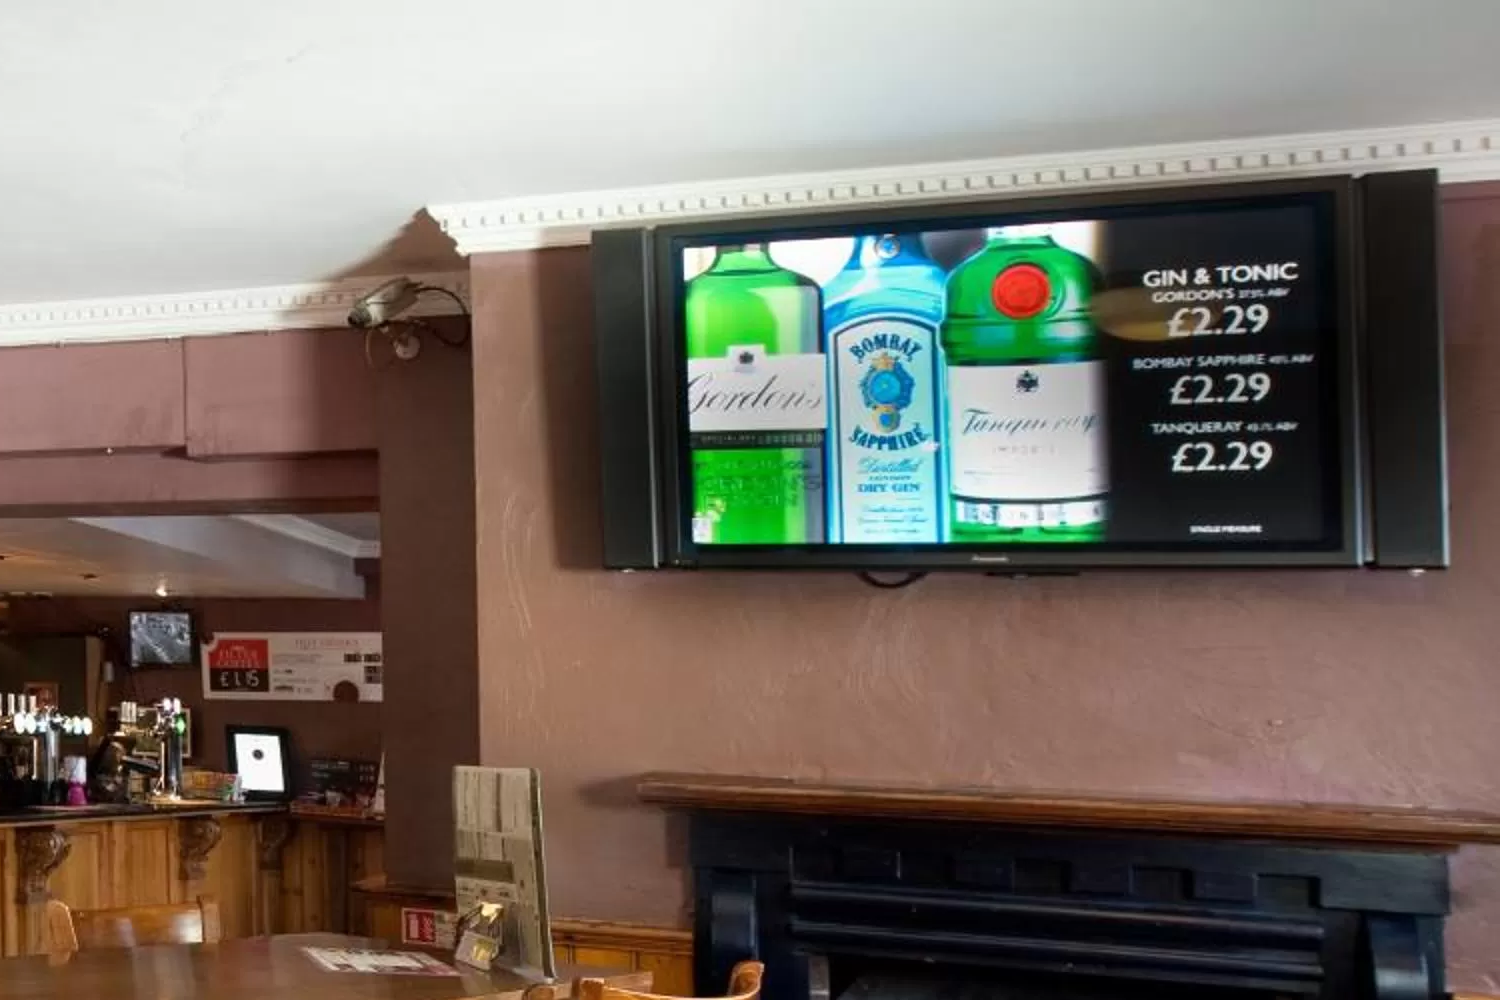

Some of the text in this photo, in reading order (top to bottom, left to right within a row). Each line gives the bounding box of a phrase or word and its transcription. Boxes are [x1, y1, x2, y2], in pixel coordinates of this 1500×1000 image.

[1143, 262, 1299, 288] GIN & TONIC
[1152, 287, 1234, 303] GORDON'S
[1166, 303, 1270, 337] £2.29
[849, 333, 923, 364] BOMBAY
[1132, 356, 1192, 370] BOMBAY
[1196, 354, 1266, 367] SAPPHIRE
[688, 371, 822, 415] Gordon's
[1169, 372, 1272, 405] £2.29
[848, 422, 932, 451] SAPPHIRE
[1150, 421, 1244, 434] TANQUERAY
[1171, 440, 1273, 472] £2.29
[857, 483, 921, 493] DRY GIN
